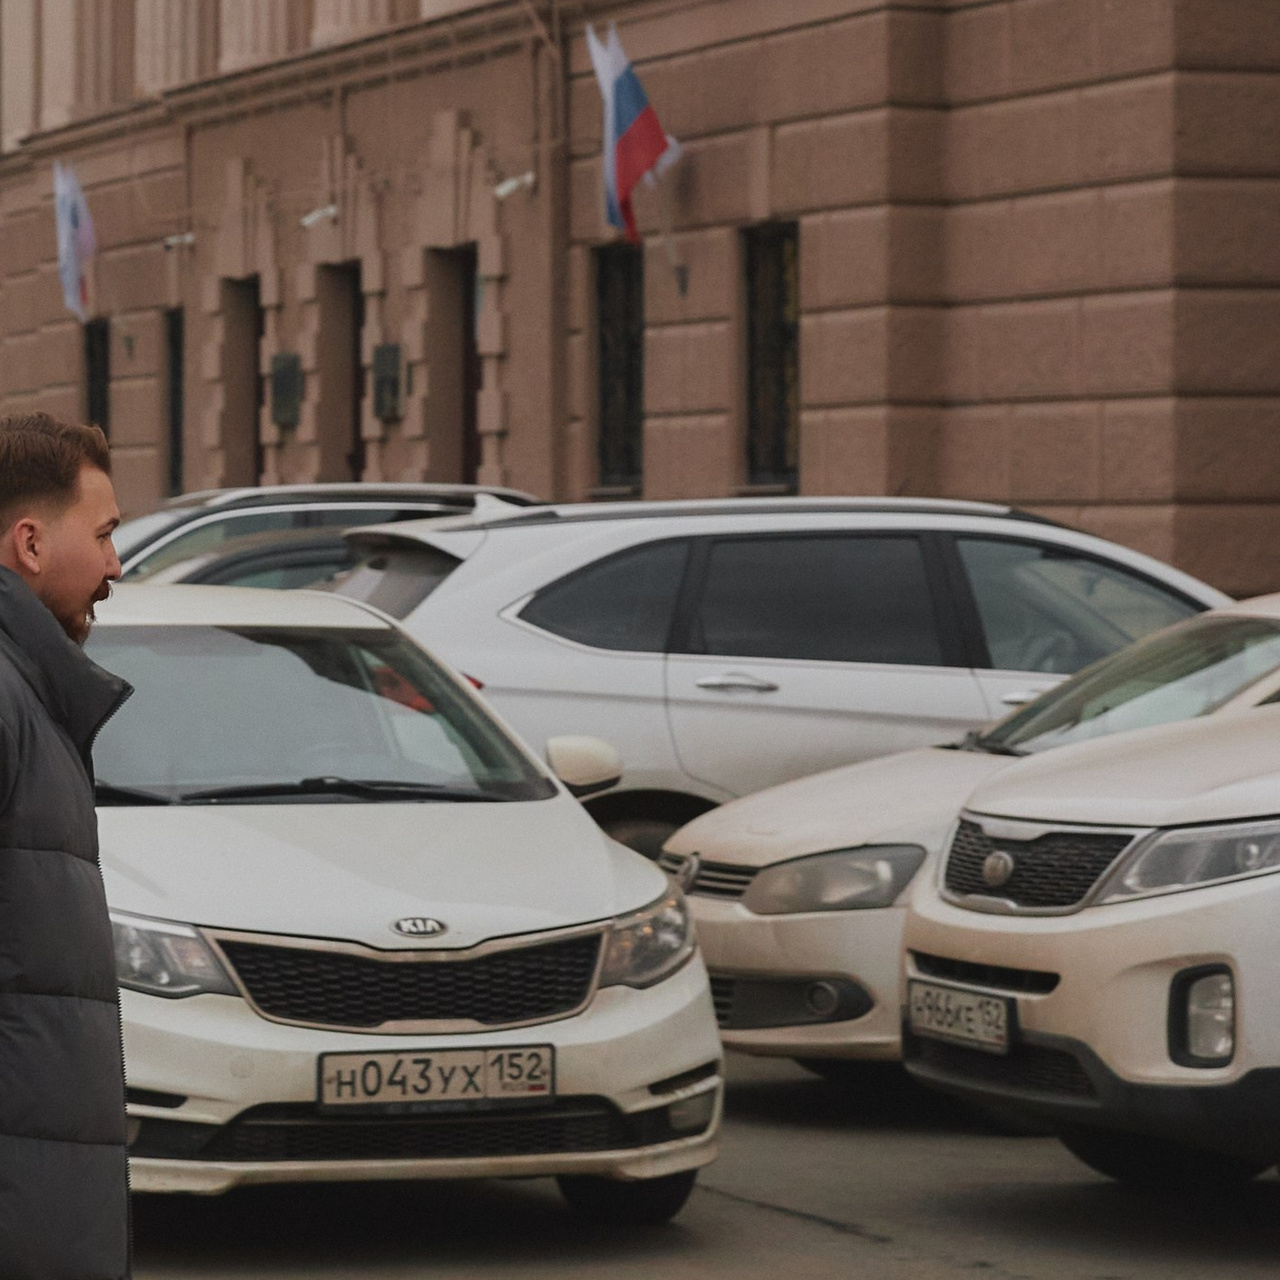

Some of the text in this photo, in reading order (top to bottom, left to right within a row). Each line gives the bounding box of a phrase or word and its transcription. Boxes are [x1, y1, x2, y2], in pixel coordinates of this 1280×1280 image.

[400, 919, 441, 932] KIA
[336, 1052, 543, 1097] Н043УХ 152
